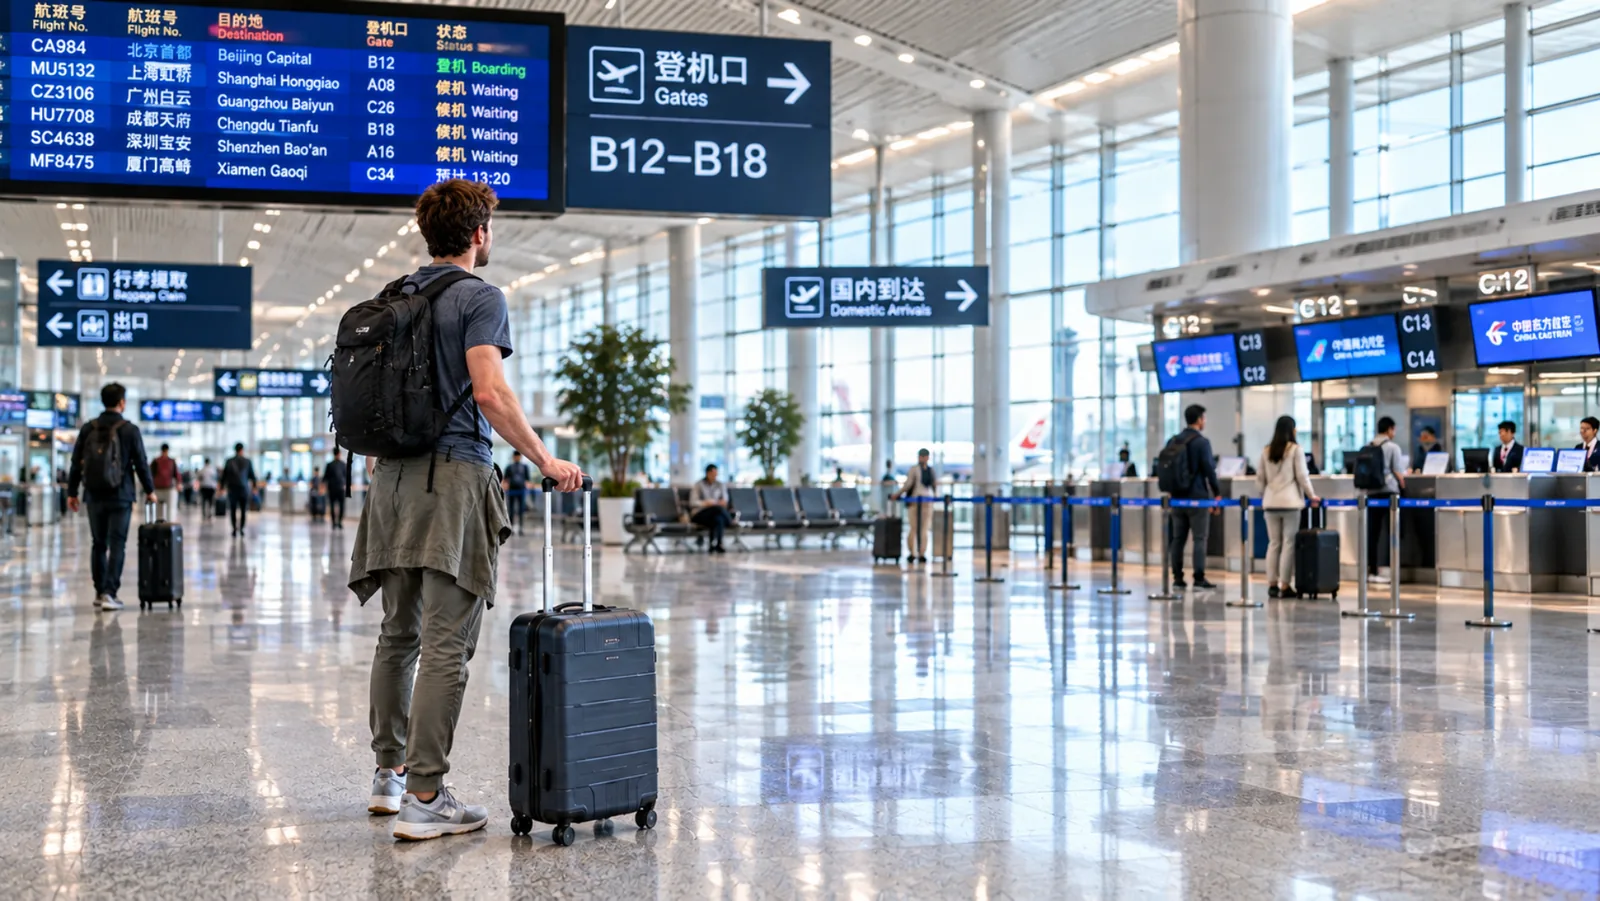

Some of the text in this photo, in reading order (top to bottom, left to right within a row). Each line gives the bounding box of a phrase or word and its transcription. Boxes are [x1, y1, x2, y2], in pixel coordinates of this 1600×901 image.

[34, 2, 86, 20] 航班号
[127, 8, 178, 25] 航班号
[32, 19, 88, 32] Flight No.
[218, 13, 263, 29] 目的地
[366, 20, 408, 36] 登机口
[127, 24, 182, 37] Flight No.
[218, 28, 284, 42] Destination
[436, 24, 467, 39] 状态
[31, 38, 86, 54] CA984
[366, 36, 394, 47] Gate
[436, 40, 473, 51] Status
[127, 42, 192, 60] 北京首都
[218, 48, 312, 67] Beijing Capital
[31, 61, 95, 78] MU5132
[368, 56, 395, 70] B12
[436, 58, 526, 79] 登机 Boarding
[654, 50, 747, 86] 登机口
[127, 62, 192, 83] 上海虹桥
[217, 71, 340, 91] Shanghai Hongqiao
[31, 84, 95, 100] CZ3106
[367, 78, 395, 92] A08
[436, 80, 518, 101] 候机 Waiting
[126, 87, 191, 106] 广州白云
[217, 94, 334, 113] Guangzhou Baiyun
[654, 87, 709, 108] Gates
[31, 107, 95, 124] HU7708
[367, 100, 395, 115] C26
[436, 102, 518, 123] 候机 Waiting
[217, 117, 319, 134] Chengdu Tianfu
[368, 122, 395, 137] B18
[31, 131, 95, 147] SC4638
[126, 133, 191, 151] 深圳宝安
[436, 124, 518, 145] 候机 Waiting
[217, 140, 328, 156] Shenzhen Bao'an
[367, 145, 395, 159] A16
[436, 146, 518, 167] 候机 Waiting
[30, 153, 95, 170] MF8475
[126, 155, 191, 175] 厦门高崎
[217, 162, 308, 181] Xiamen Gaoqi
[366, 167, 395, 181] C34
[472, 172, 511, 185] 13:20
[113, 288, 157, 303] Baggage
[830, 276, 925, 302] 国内到达
[830, 303, 932, 317] Domestic Arrivals
[113, 311, 148, 330] 出口
[1402, 313, 1432, 333] C13
[1239, 333, 1262, 351] C13
[1407, 349, 1436, 368] C14
[1243, 365, 1266, 382] C12
